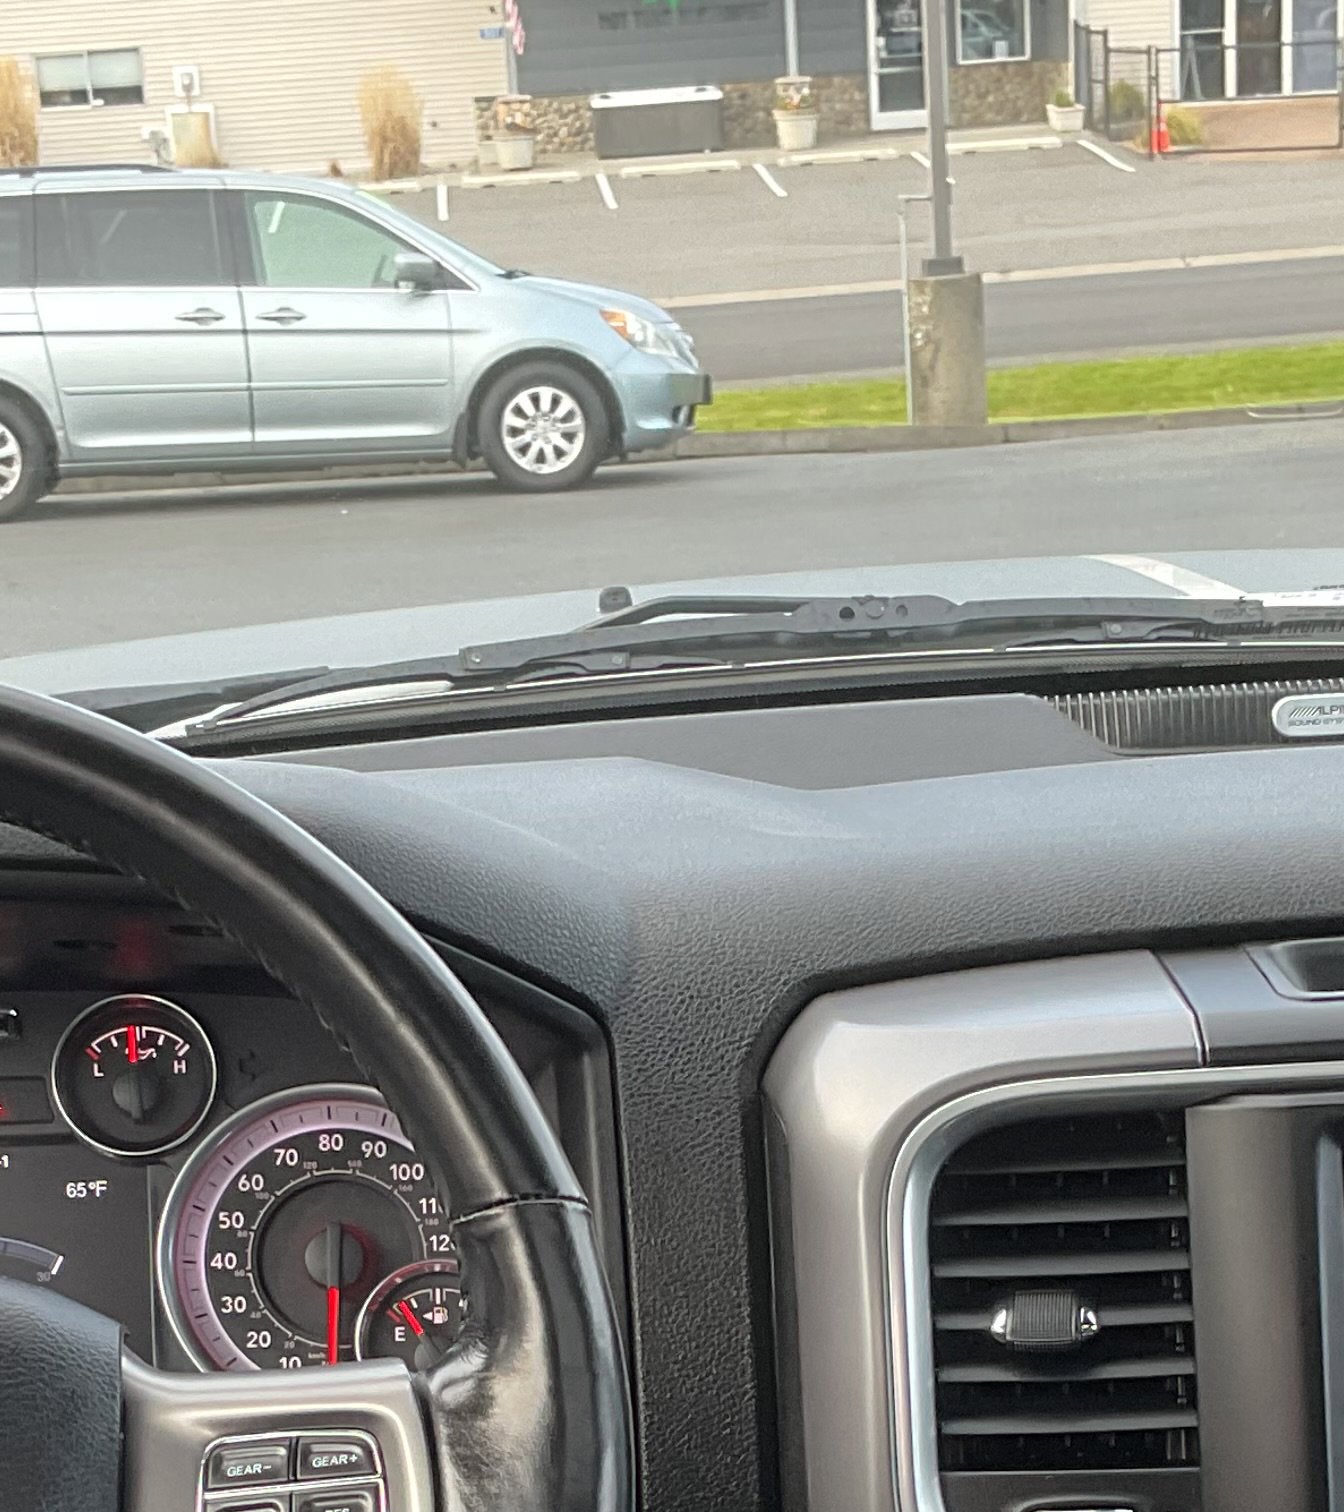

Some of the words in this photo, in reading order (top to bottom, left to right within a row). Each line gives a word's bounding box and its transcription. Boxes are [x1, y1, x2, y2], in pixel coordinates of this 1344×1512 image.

[94, 1063, 104, 1077] L
[174, 1060, 186, 1074] H
[318, 1133, 344, 1152] 80
[361, 1140, 387, 1158] 90
[273, 1148, 298, 1166] 70
[389, 1163, 424, 1181] 100
[66, 1180, 108, 1198] 65°F
[238, 1174, 264, 1191] 60
[419, 1197, 444, 1214] 11
[218, 1211, 245, 1229] 50
[429, 1234, 456, 1252] 12
[210, 1252, 237, 1269] 40
[36, 1272, 51, 1282] 30
[220, 1295, 247, 1313] 30
[246, 1330, 271, 1349] 20
[394, 1326, 406, 1342] E
[279, 1356, 302, 1369] 10
